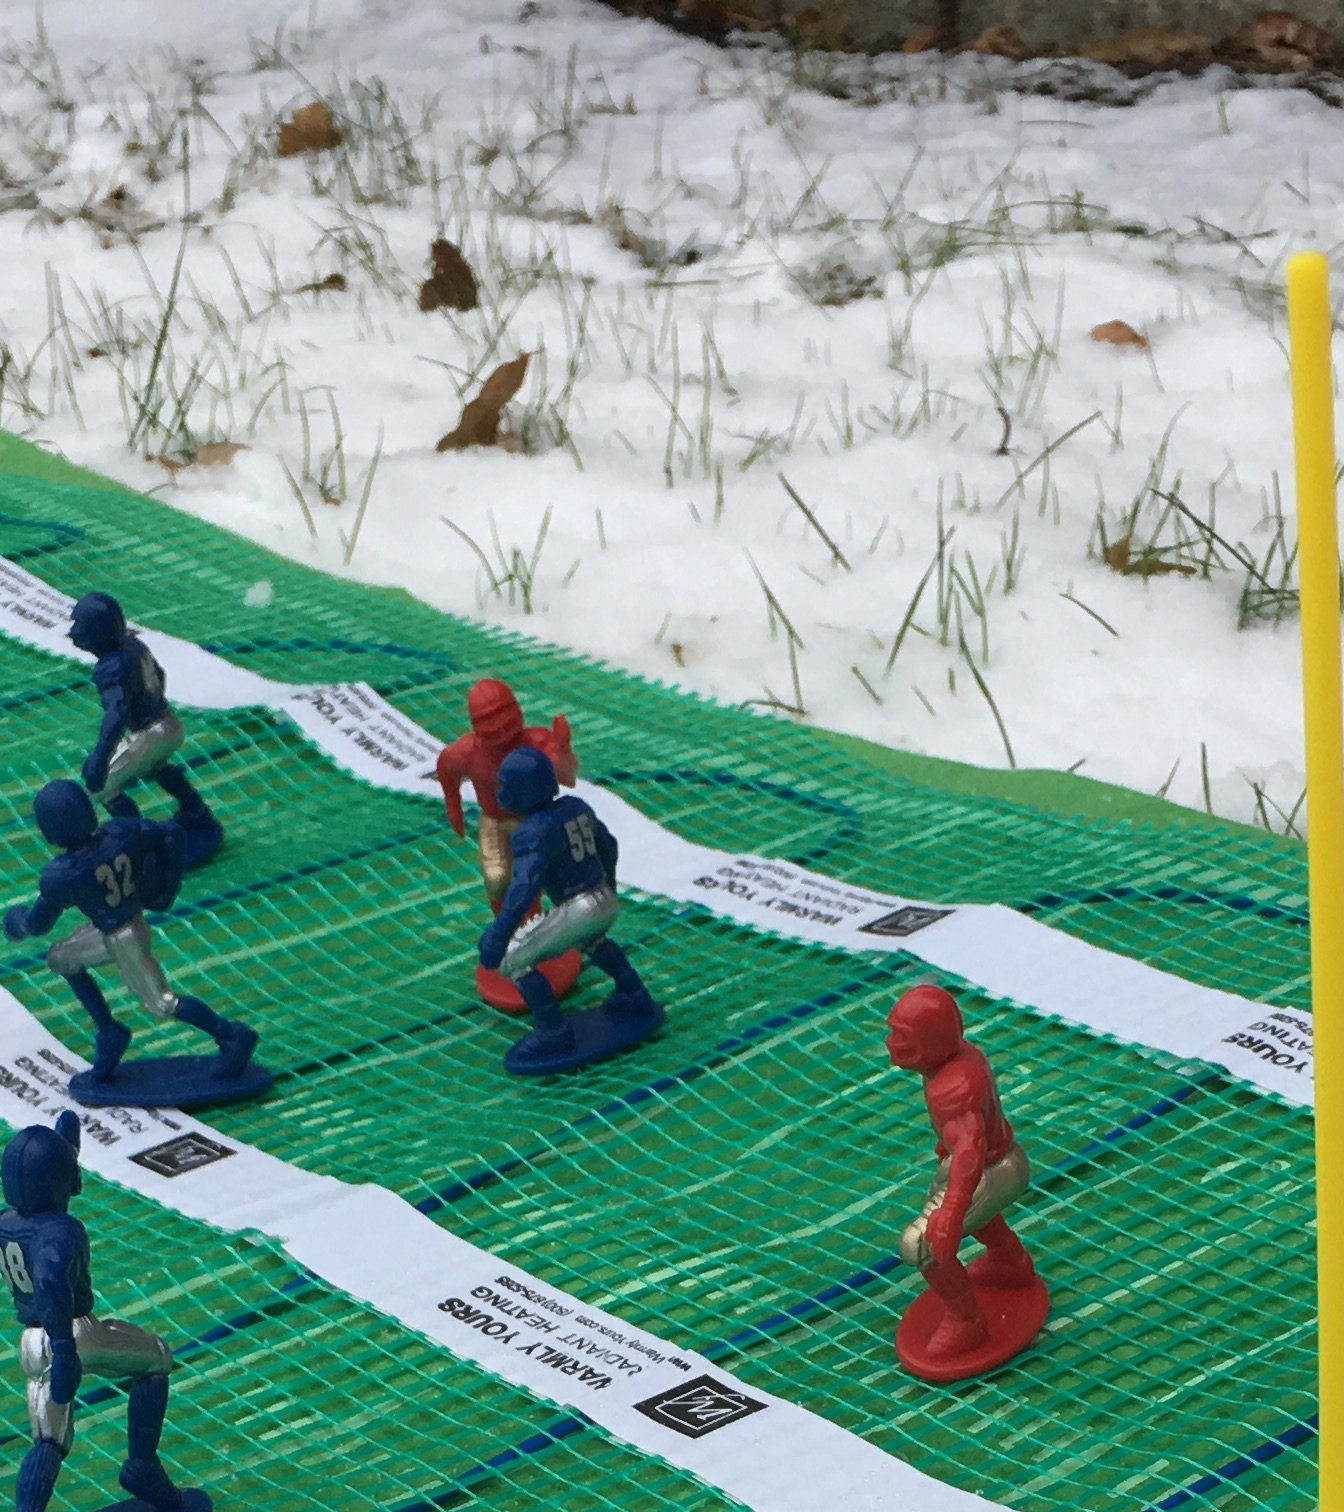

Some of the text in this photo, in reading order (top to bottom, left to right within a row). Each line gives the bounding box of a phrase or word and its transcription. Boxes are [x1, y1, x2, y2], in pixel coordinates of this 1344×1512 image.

[563, 813, 596, 862] 55
[96, 854, 136, 908] 32
[1222, 1033, 1308, 1073] YOURS
[438, 1298, 520, 1344] YOURS
[470, 1286, 560, 1333] HEATING
